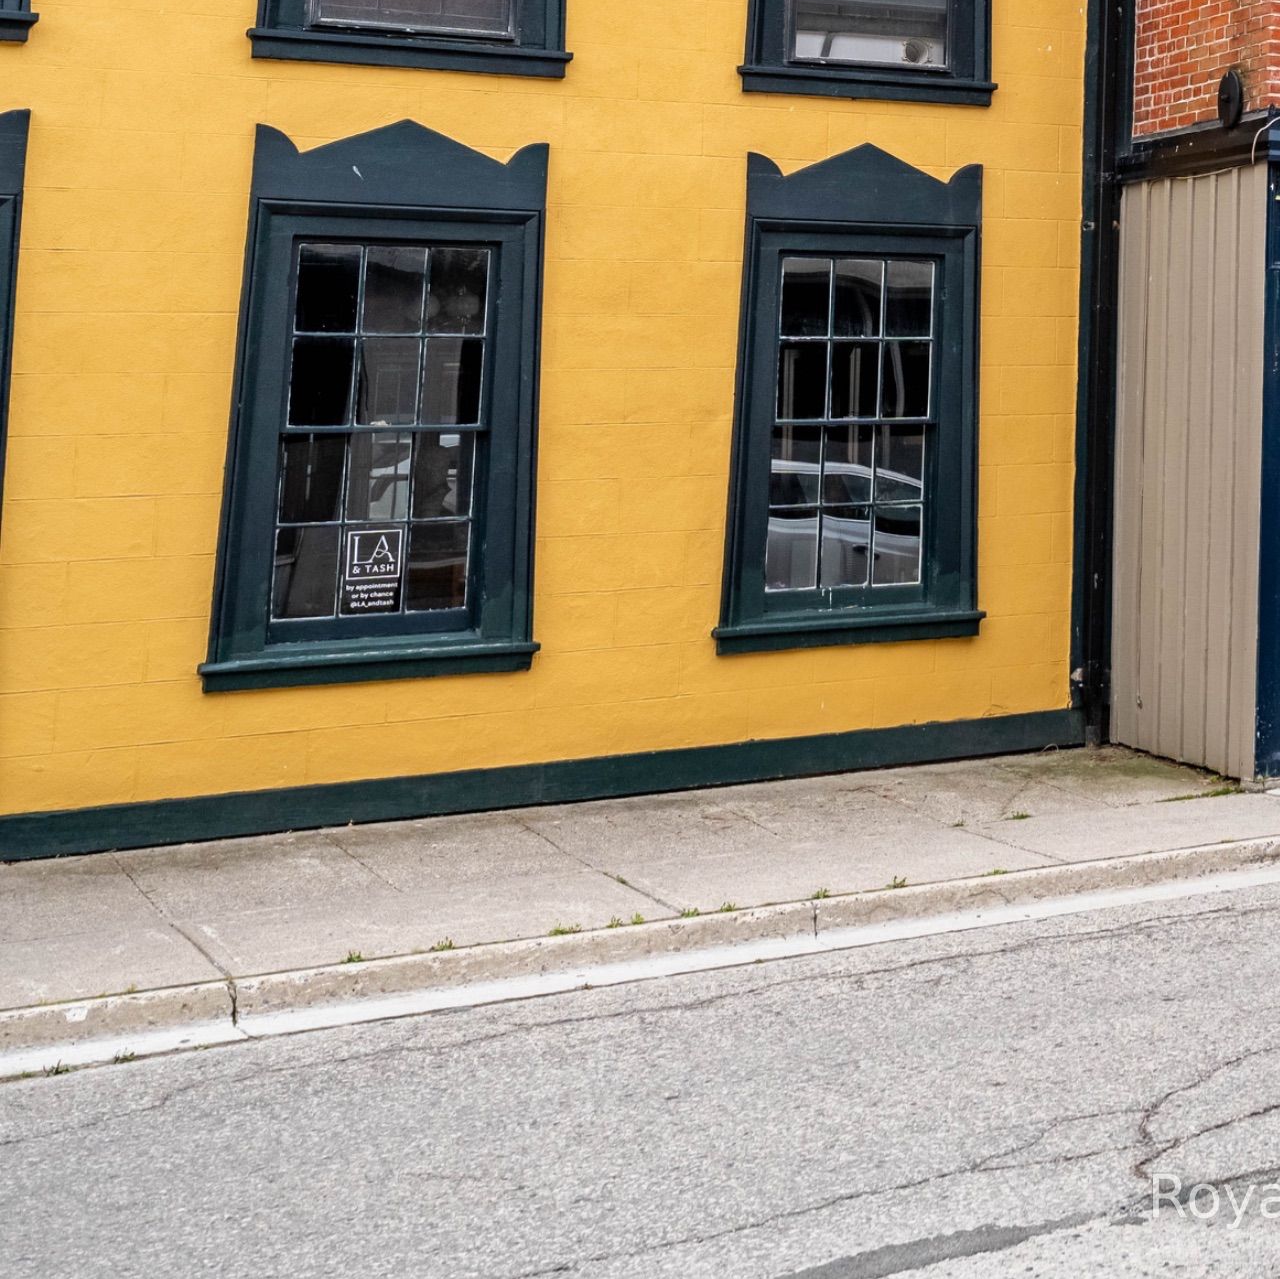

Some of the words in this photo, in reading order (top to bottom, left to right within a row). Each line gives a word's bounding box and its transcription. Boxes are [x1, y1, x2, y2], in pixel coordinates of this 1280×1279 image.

[352, 535, 395, 564] LA
[352, 566, 361, 574] &
[365, 564, 394, 573] TASH
[356, 582, 398, 591] appointment
